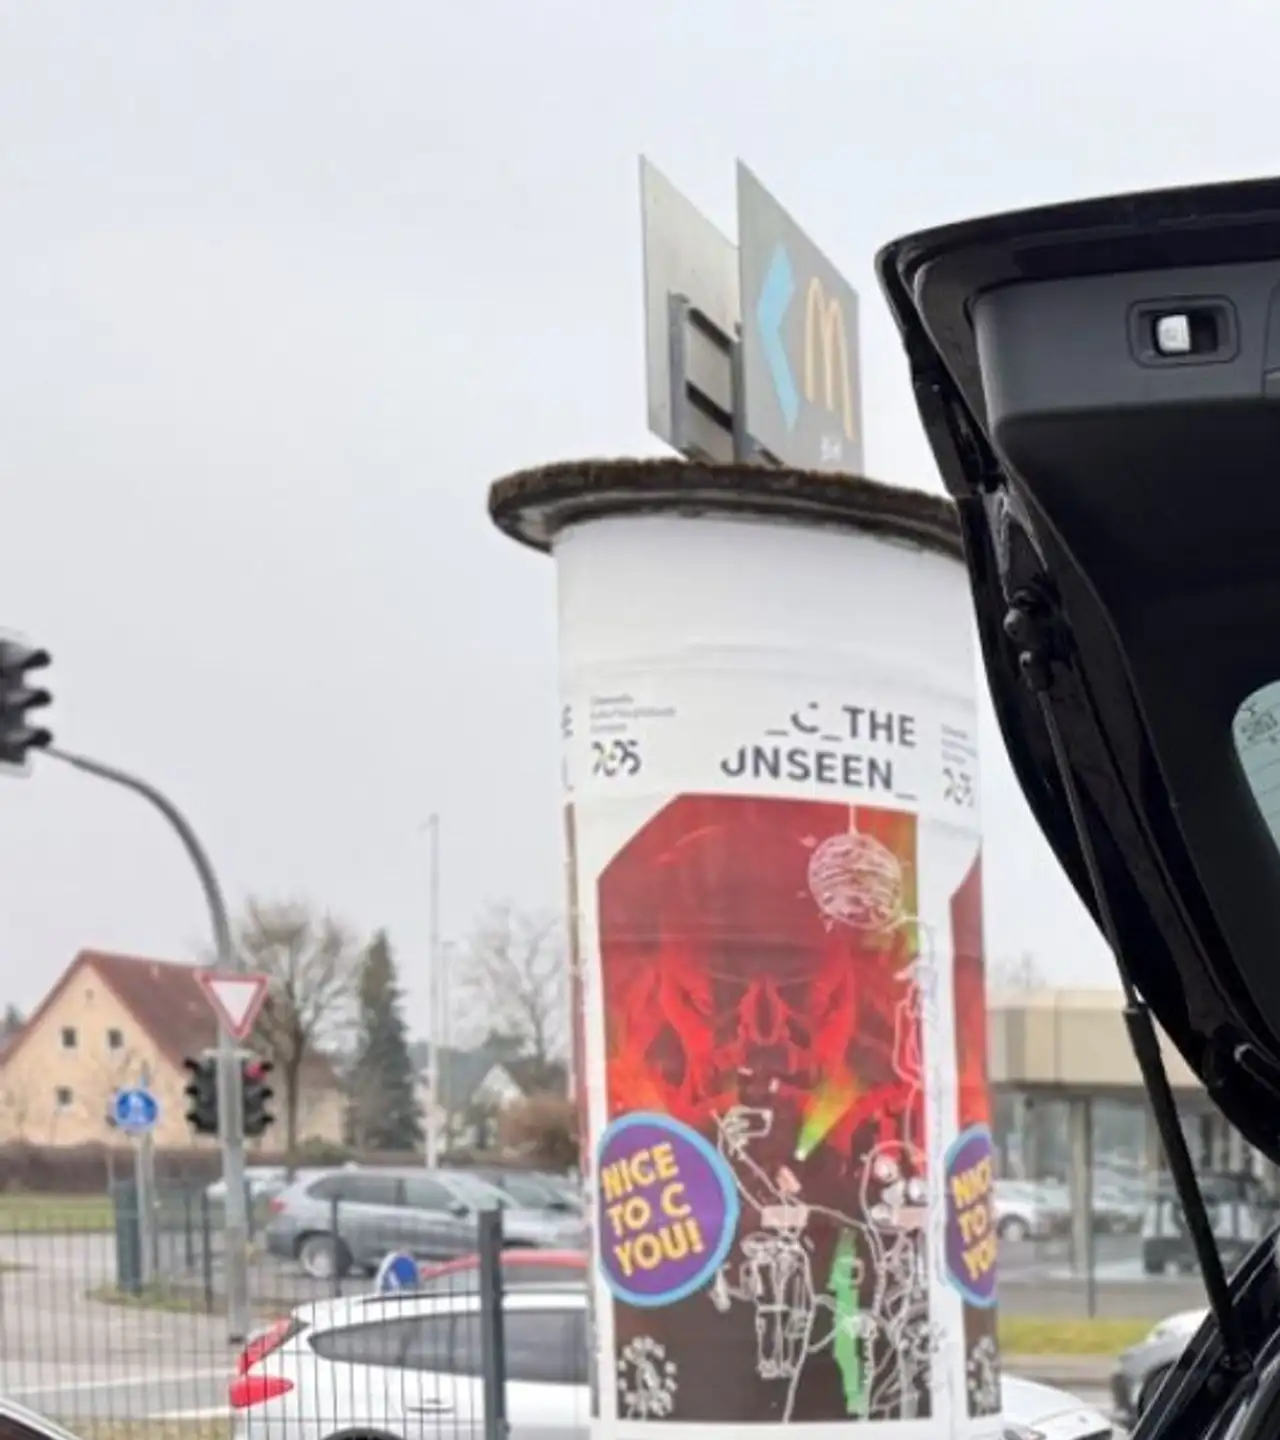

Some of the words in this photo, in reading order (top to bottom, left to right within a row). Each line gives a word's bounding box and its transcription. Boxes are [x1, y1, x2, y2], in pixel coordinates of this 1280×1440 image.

[602, 1141, 679, 1202] NICE
[606, 1196, 651, 1237] TO
[660, 1182, 692, 1217] C
[613, 1217, 705, 1277] YOU!
